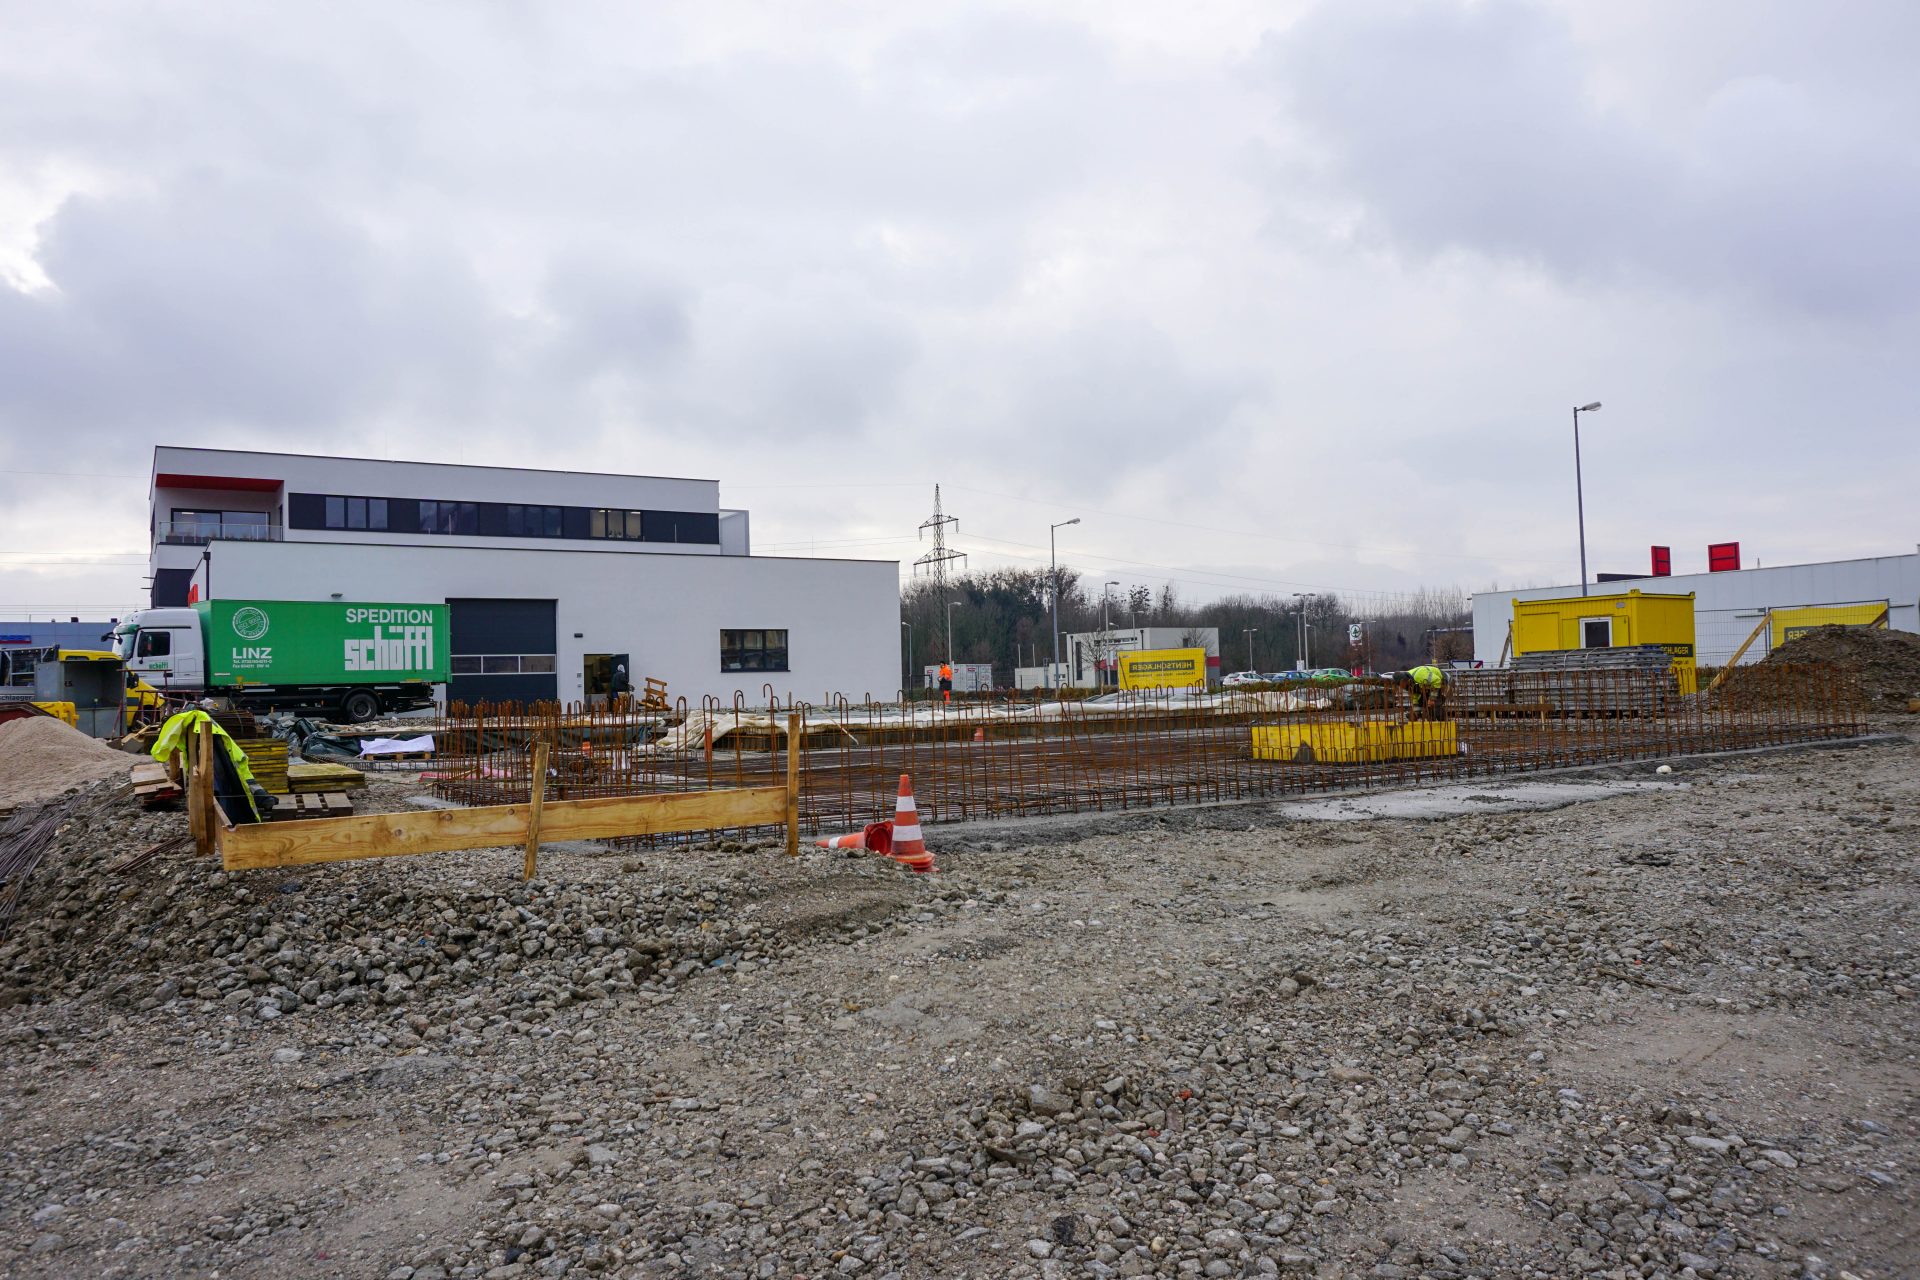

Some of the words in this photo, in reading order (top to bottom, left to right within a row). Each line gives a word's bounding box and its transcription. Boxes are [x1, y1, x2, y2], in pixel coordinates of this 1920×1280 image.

[346, 608, 433, 624] SPEDITION
[232, 647, 272, 659] LINZ
[344, 626, 434, 671] schöffl
